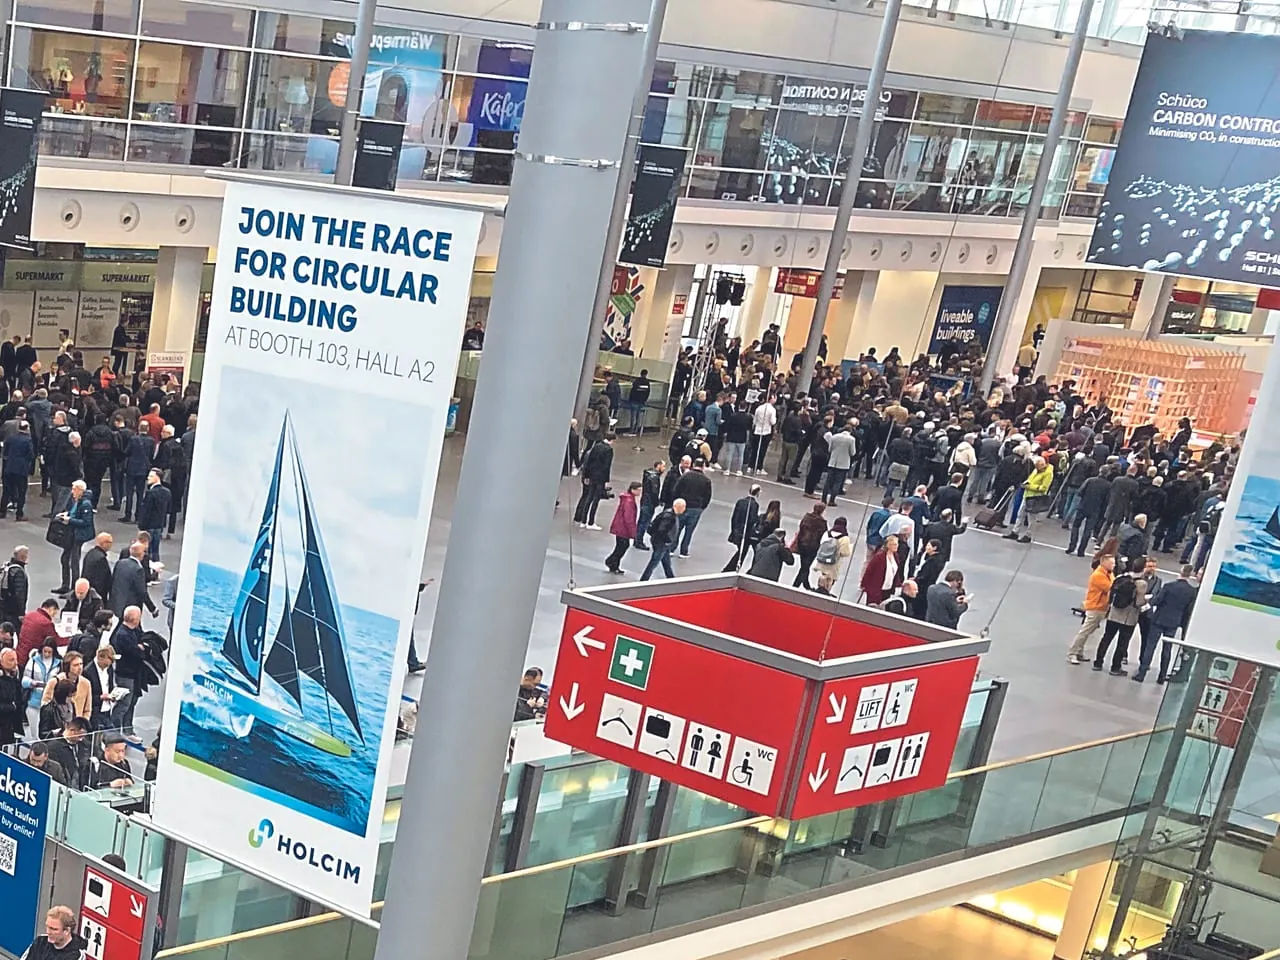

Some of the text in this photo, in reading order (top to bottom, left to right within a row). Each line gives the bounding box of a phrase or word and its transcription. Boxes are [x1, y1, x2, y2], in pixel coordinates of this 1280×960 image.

[480, 92, 526, 125] Käfer
[1157, 92, 1208, 109] Schüco
[1153, 109, 1280, 134] CARBON CONTRO
[1148, 126, 1198, 142] Minimising
[1218, 132, 1228, 143] in
[1229, 135, 1280, 148] constructio
[238, 206, 453, 263] JOIN THE RACE
[15, 271, 150, 283] SUPERMARKT SUPERMARKET
[234, 246, 439, 305] FOR CIRCULAR
[229, 286, 358, 333] BUILDING
[940, 308, 974, 323] liveable
[936, 325, 975, 343] buildings
[224, 325, 436, 384] AT BOOTH 103, HALL A2
[904, 682, 915, 694] WC
[858, 700, 882, 718] LIFT
[757, 748, 775, 762] WC
[1, 814, 13, 830] buy
[13, 823, 35, 839] online!
[14, 807, 39, 828] kaufen!
[277, 834, 361, 884] HOLCIM
